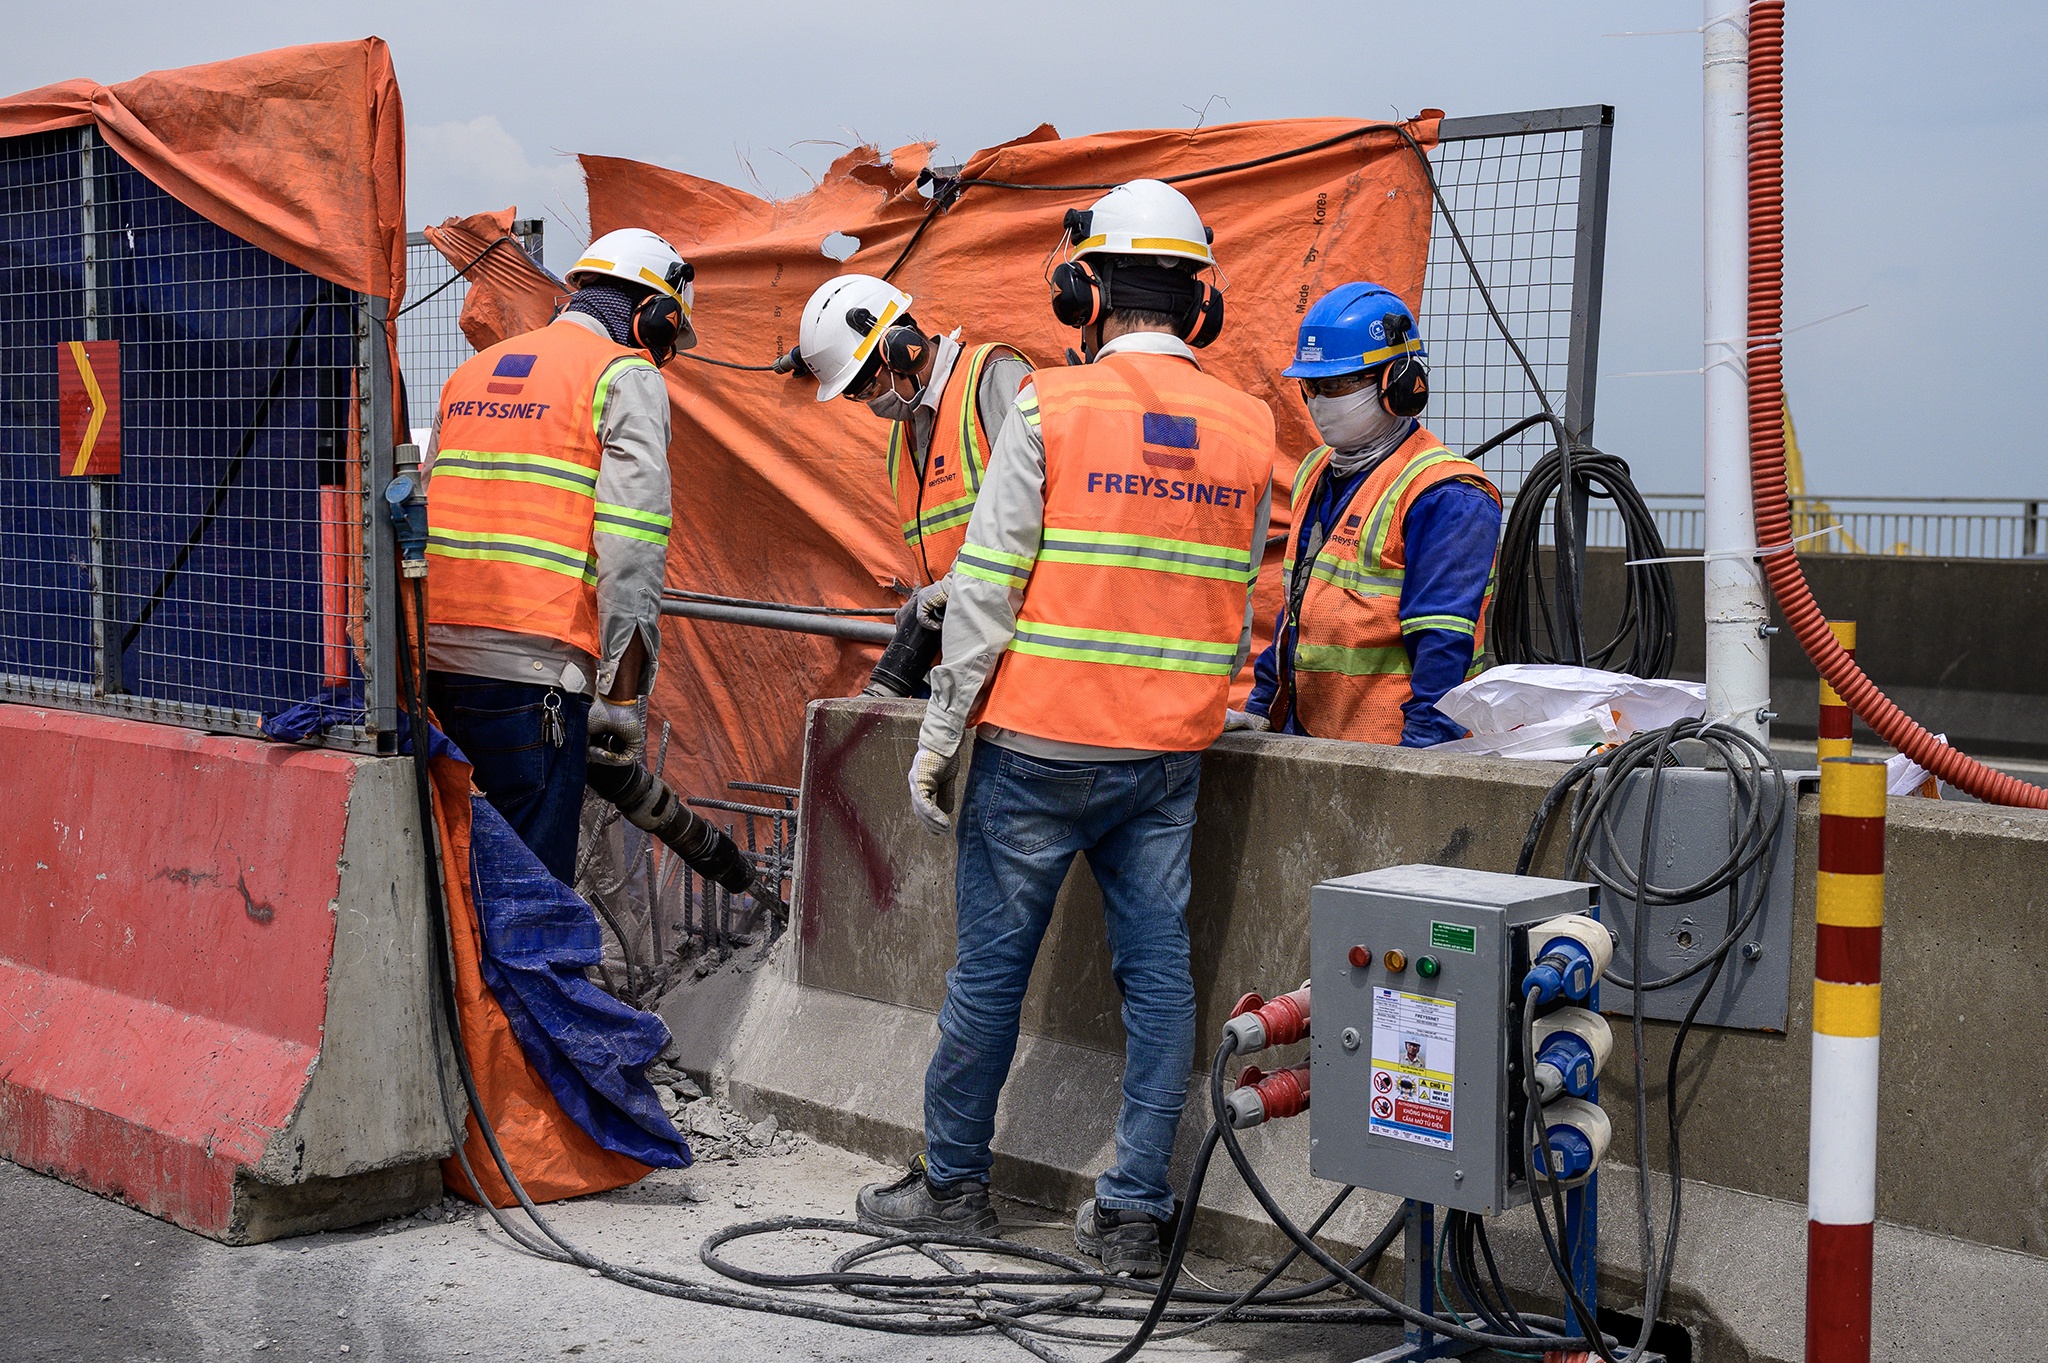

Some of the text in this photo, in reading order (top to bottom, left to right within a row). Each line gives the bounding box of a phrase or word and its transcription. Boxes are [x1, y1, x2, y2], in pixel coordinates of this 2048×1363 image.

[1295, 284, 1309, 314] Made
[1313, 192, 1327, 226] Korea
[447, 400, 550, 420] FREYSSINET
[1087, 472, 1247, 509] FREYSSINET
[1415, 1013, 1439, 1022] FREYSSINET
